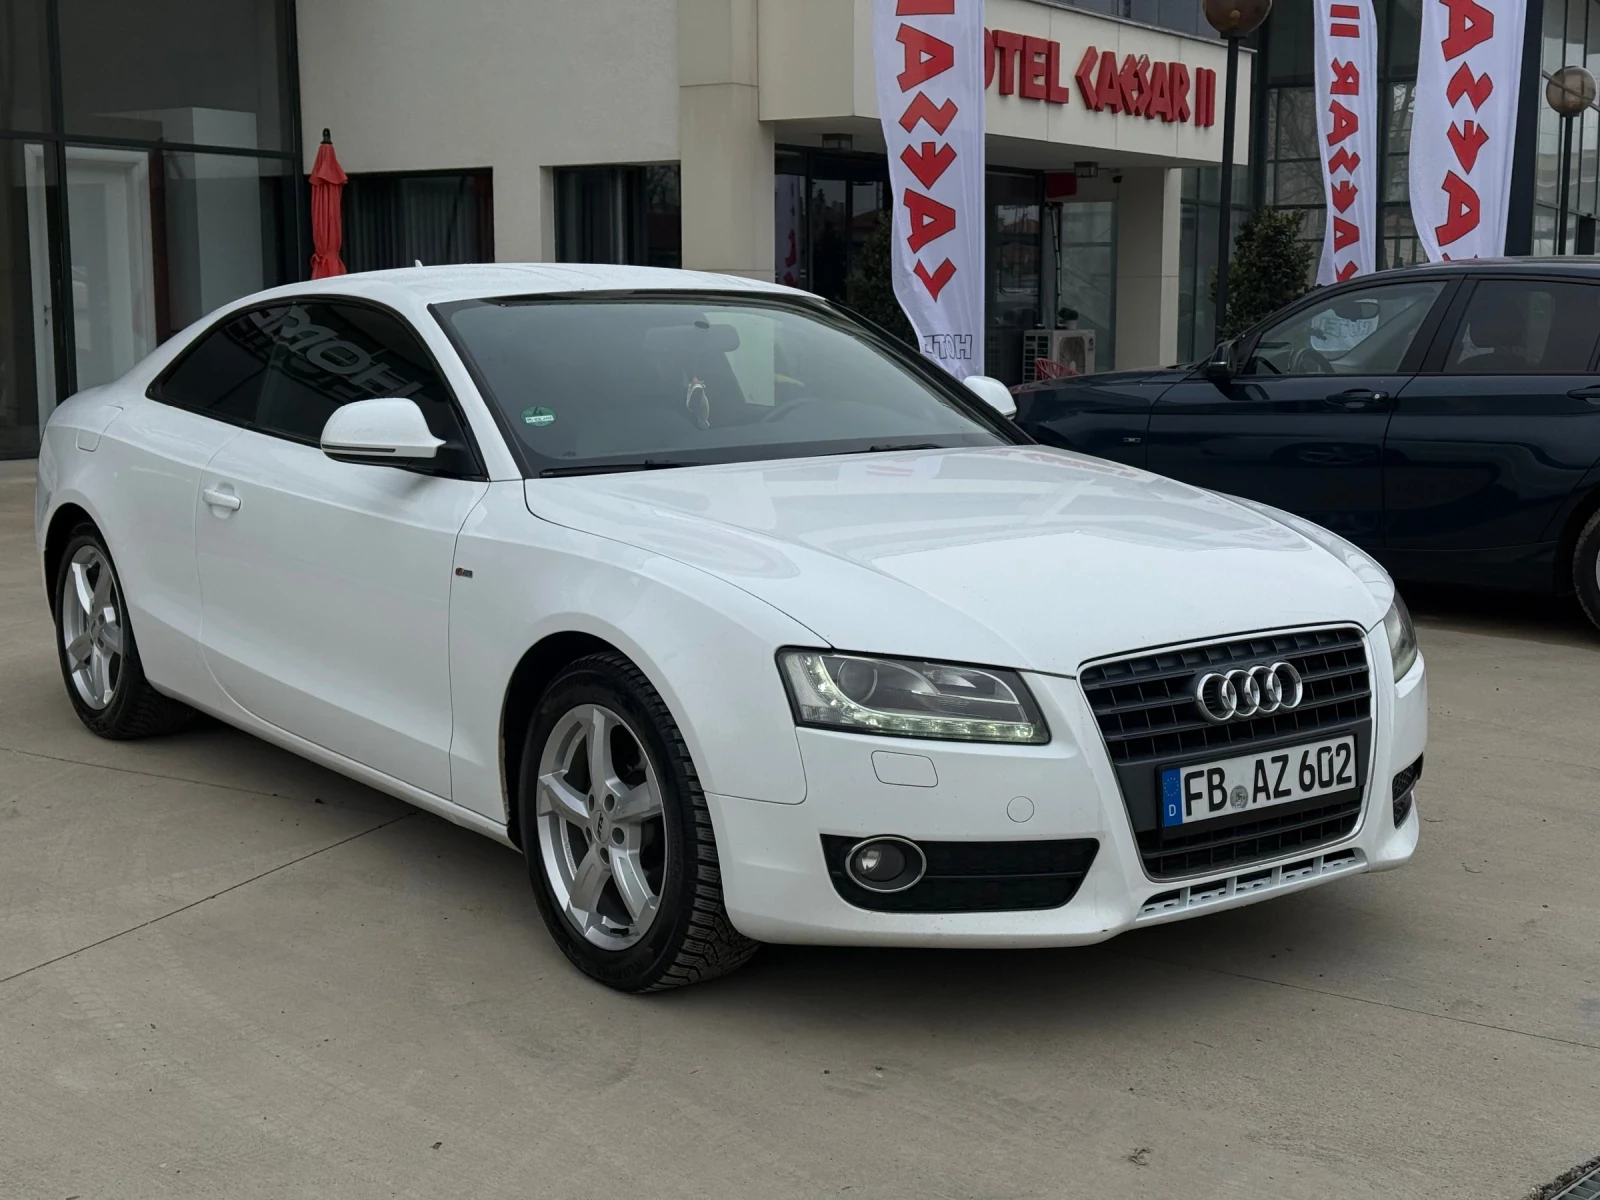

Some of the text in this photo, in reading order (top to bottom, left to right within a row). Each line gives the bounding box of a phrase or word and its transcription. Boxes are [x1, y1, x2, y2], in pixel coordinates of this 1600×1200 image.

[1075, 46, 1191, 123] CAESAR
[1195, 67, 1216, 127] II
[1168, 804, 1177, 817] D
[1184, 767, 1227, 816] FB
[1253, 754, 1291, 803] AZ
[1299, 742, 1352, 792] 602
